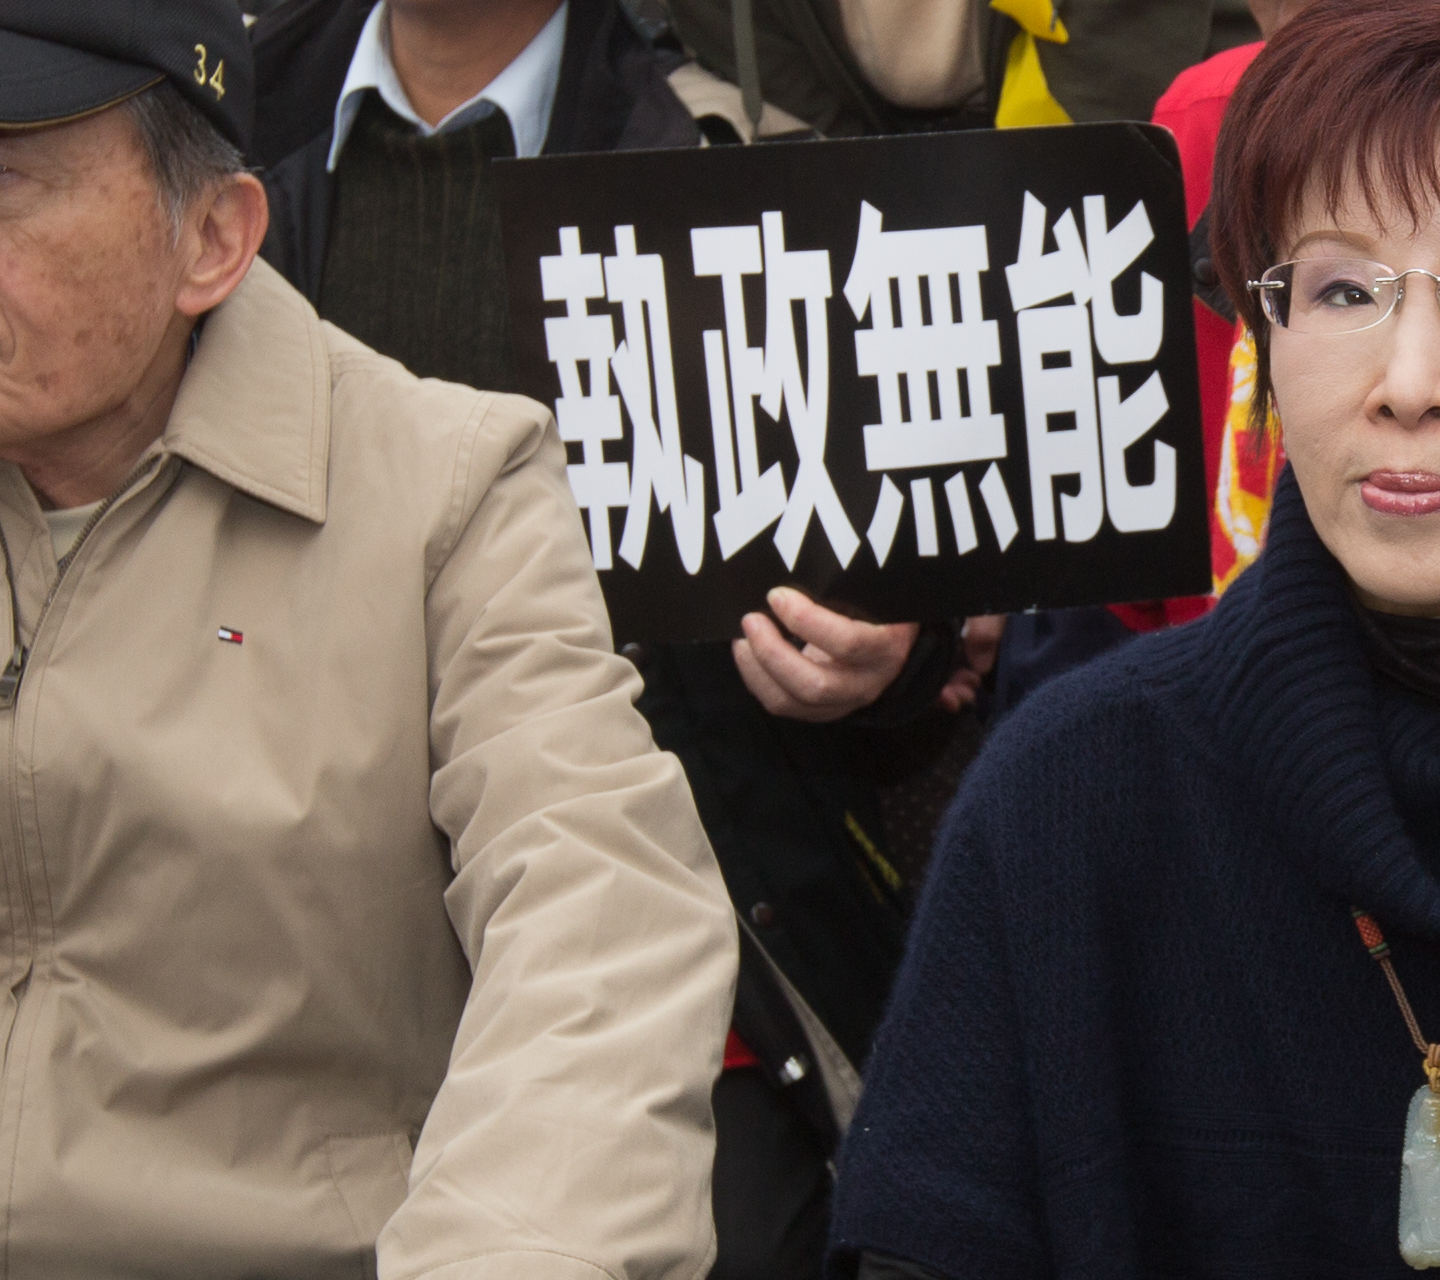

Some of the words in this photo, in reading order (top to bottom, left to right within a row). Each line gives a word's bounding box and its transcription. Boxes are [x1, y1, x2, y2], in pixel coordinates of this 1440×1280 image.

[194, 43, 226, 100] 34
[540, 190, 1177, 575] 執政無能
